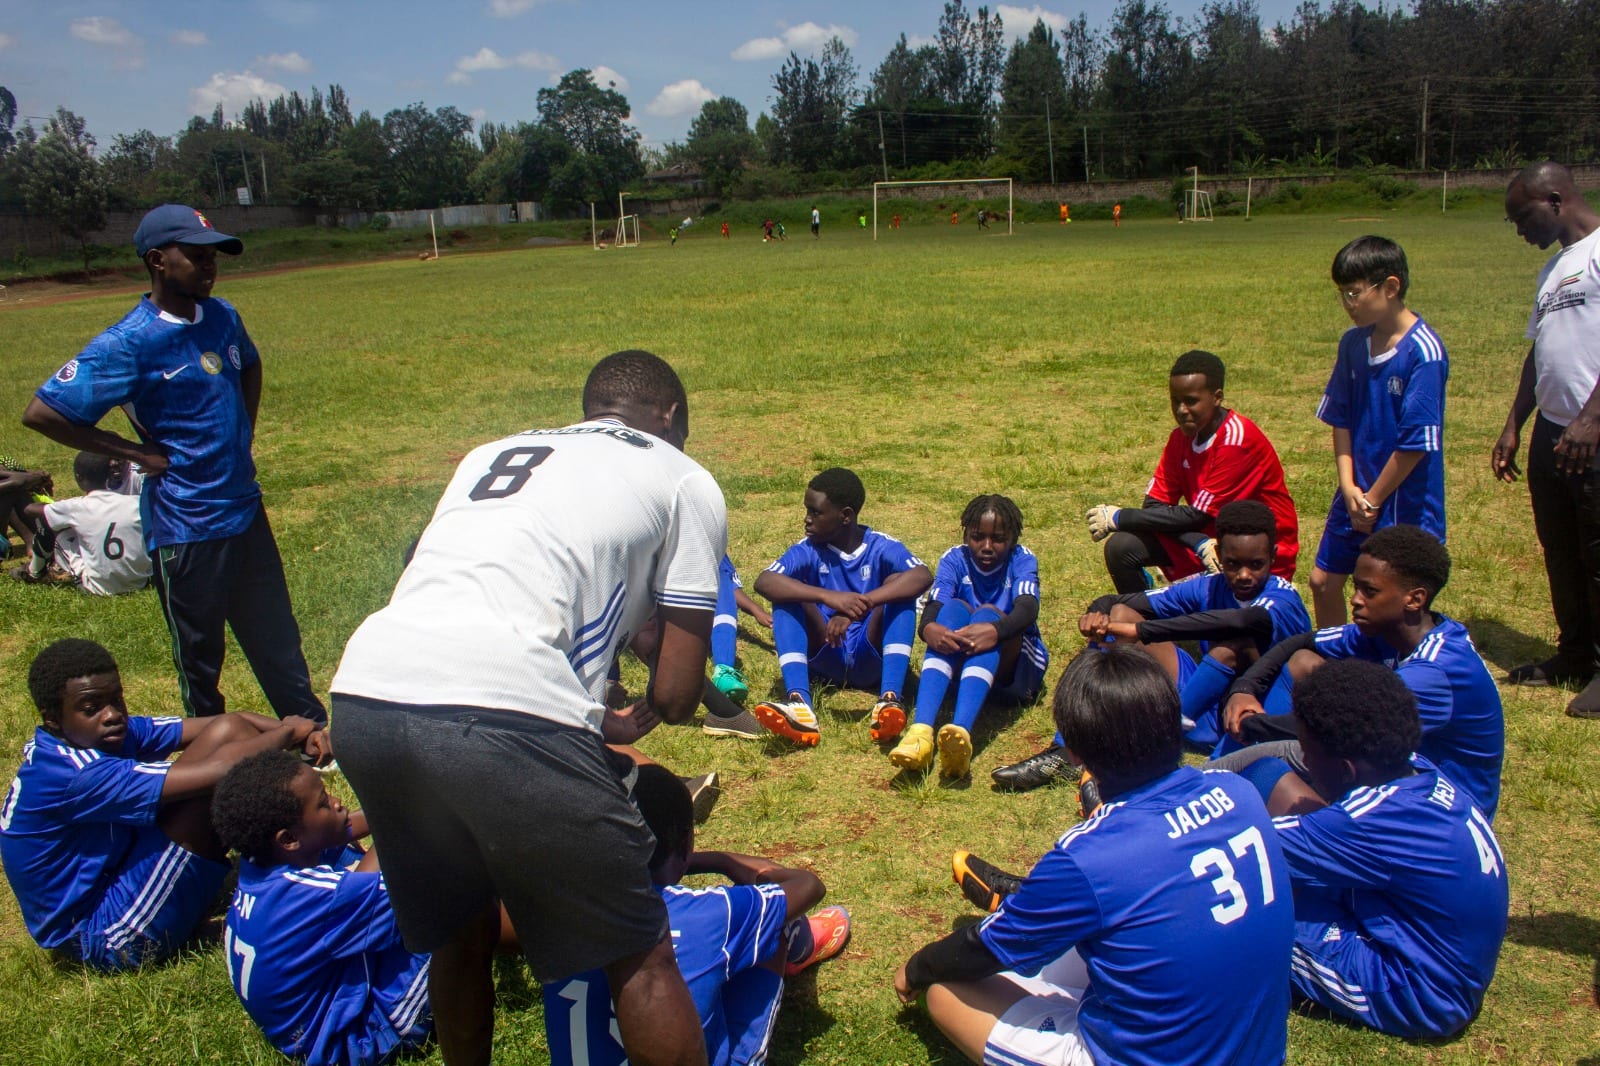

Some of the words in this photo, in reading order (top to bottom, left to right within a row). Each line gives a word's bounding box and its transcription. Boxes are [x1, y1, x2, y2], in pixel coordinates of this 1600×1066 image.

[468, 446, 555, 502] 8
[103, 522, 125, 560] 6
[1164, 786, 1236, 840] JACOB
[1465, 806, 1504, 879] 41
[1190, 825, 1275, 925] 37
[557, 979, 629, 1066] 1
